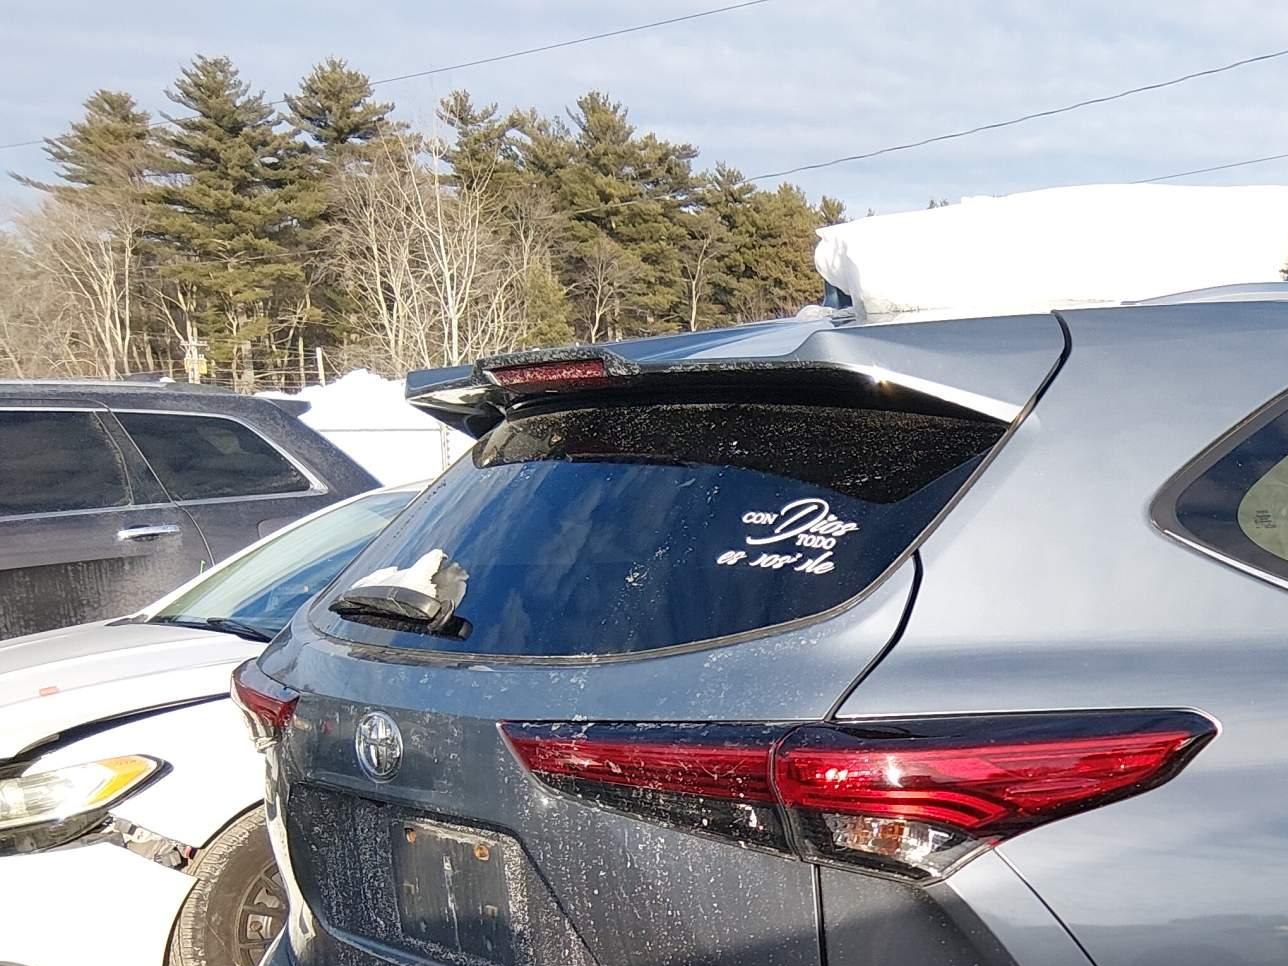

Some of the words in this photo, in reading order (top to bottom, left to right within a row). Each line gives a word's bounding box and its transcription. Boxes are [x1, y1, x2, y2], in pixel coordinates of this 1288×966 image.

[742, 511, 778, 525] CON
[746, 498, 860, 545] Dios
[795, 534, 837, 550] TODO
[717, 550, 747, 565] es
